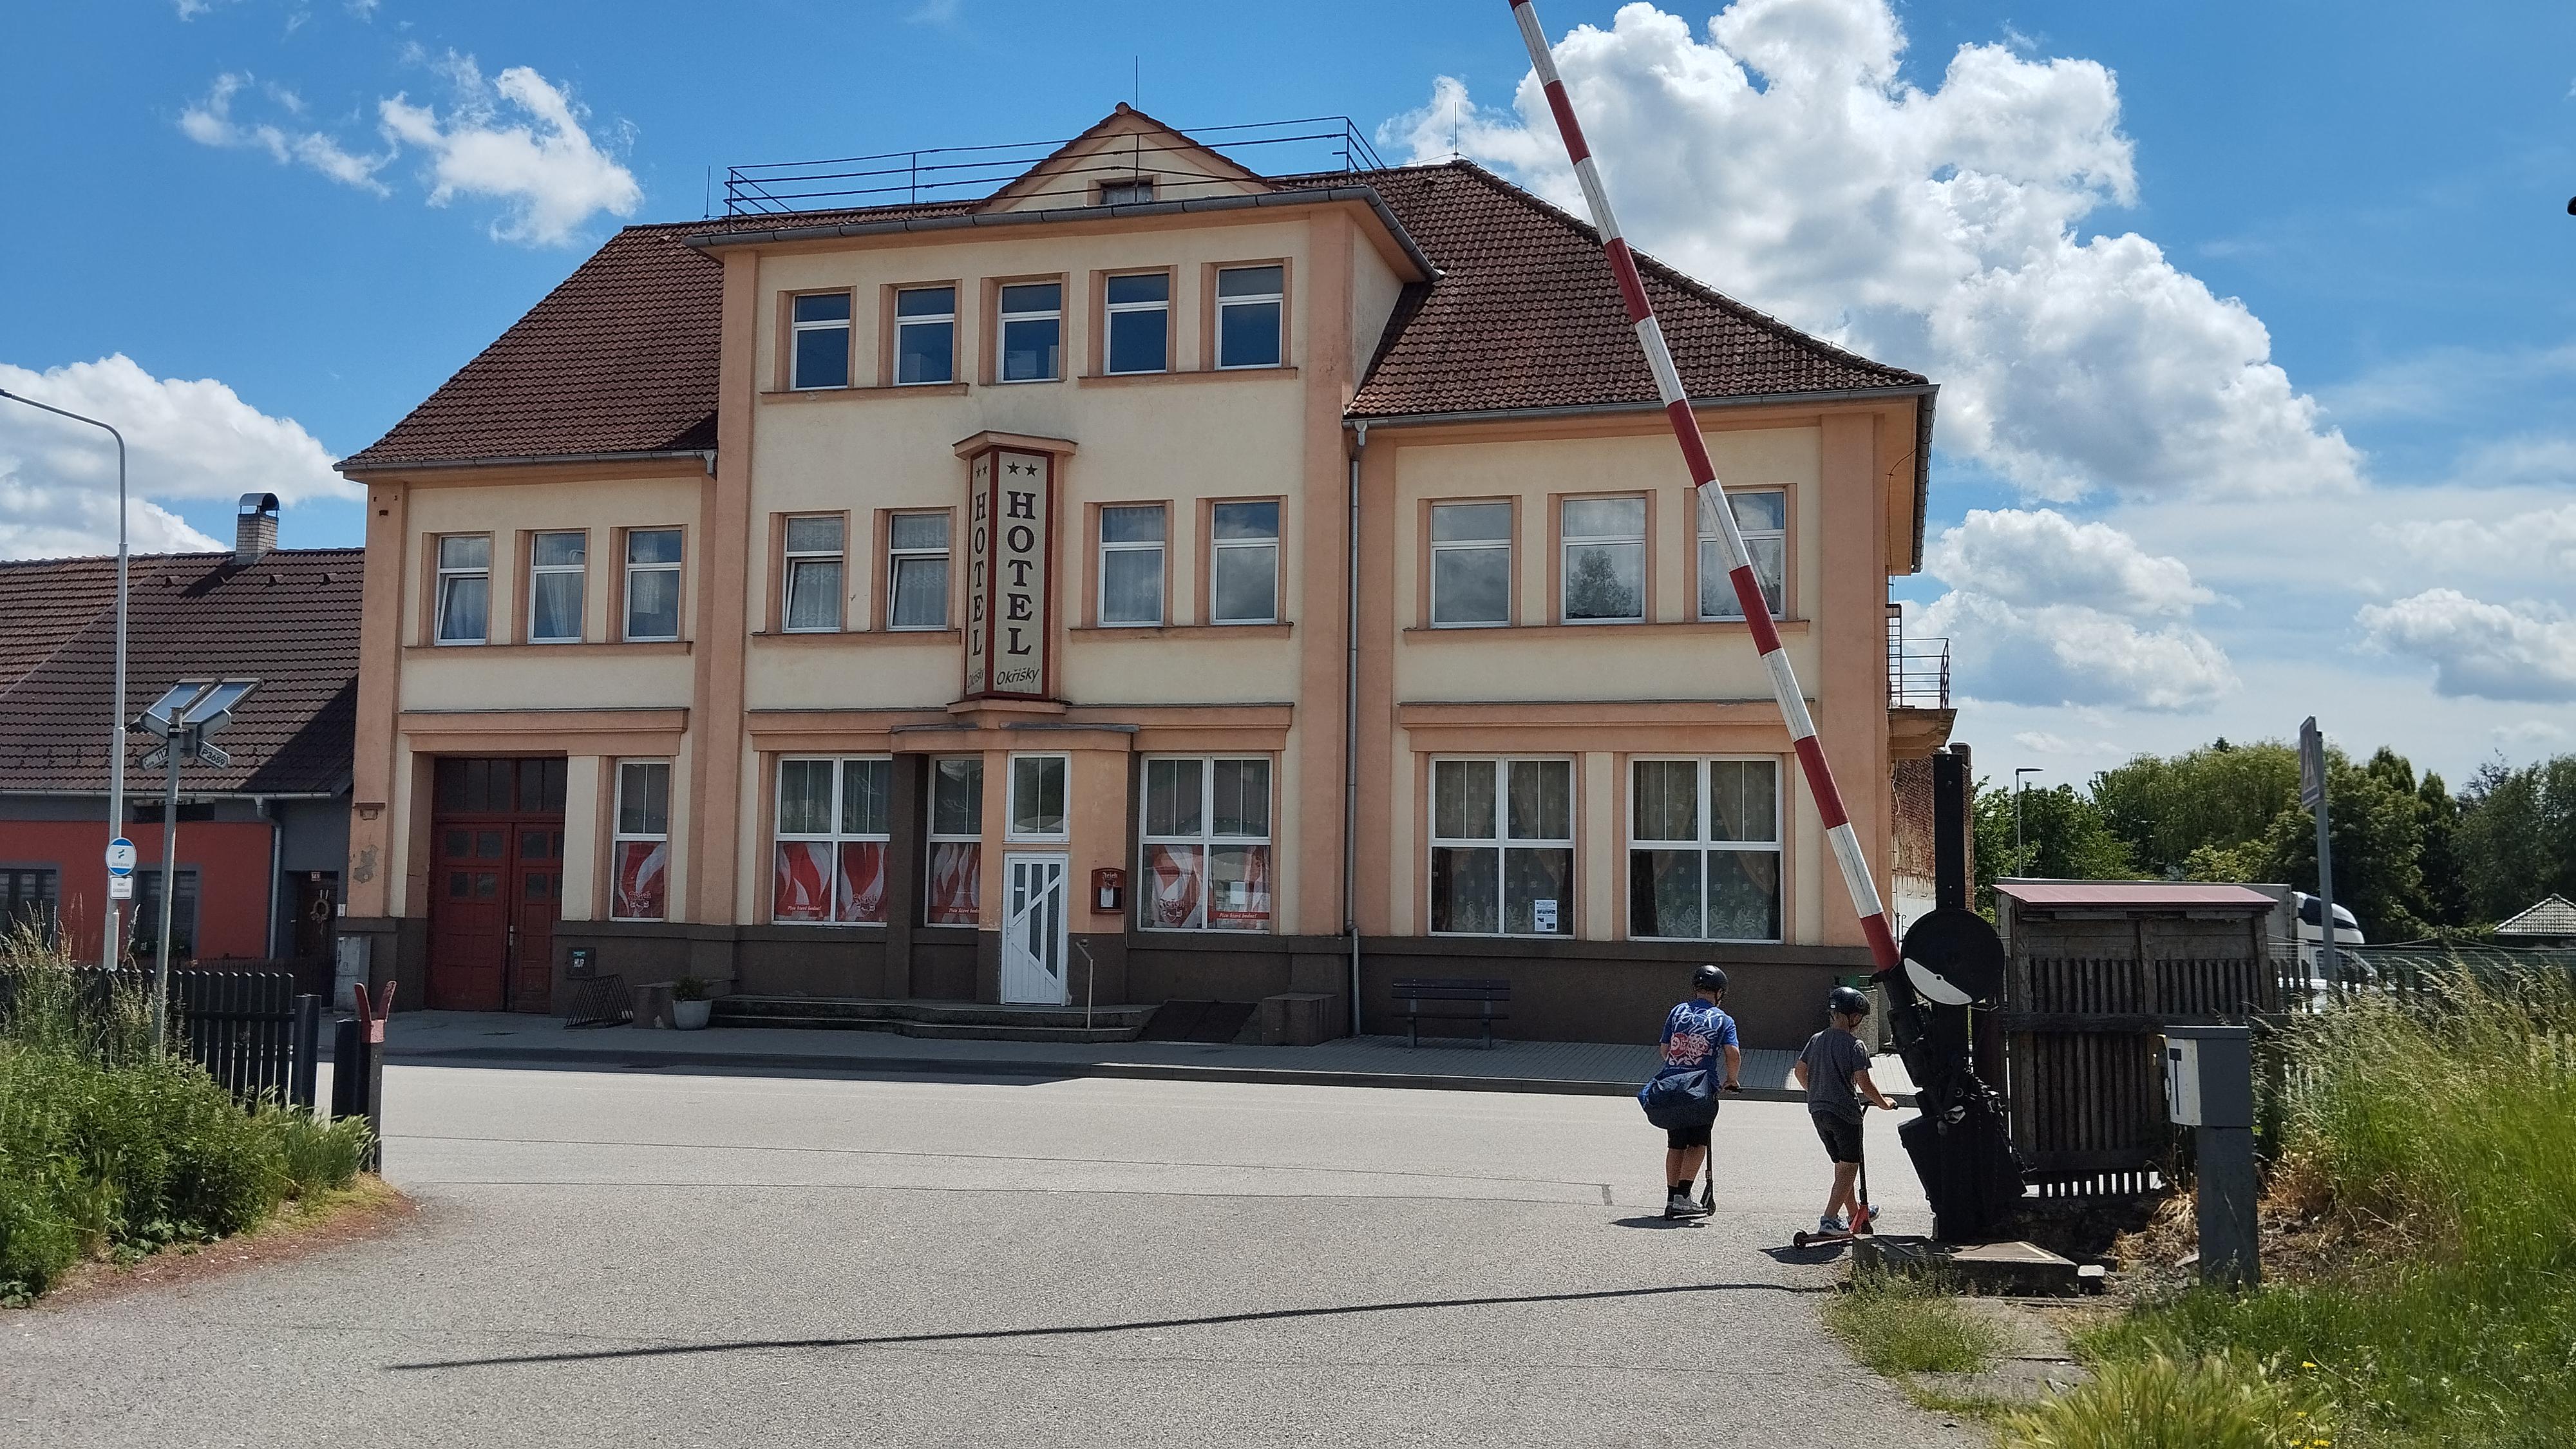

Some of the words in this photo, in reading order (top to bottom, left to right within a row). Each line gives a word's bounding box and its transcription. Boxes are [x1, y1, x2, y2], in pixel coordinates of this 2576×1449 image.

[973, 492, 987, 656] HOTEL
[1007, 491, 1036, 656] HOTEL
[996, 667, 1040, 685] Okříšky
[155, 747, 169, 761] 112
[201, 748, 225, 766] P3659
